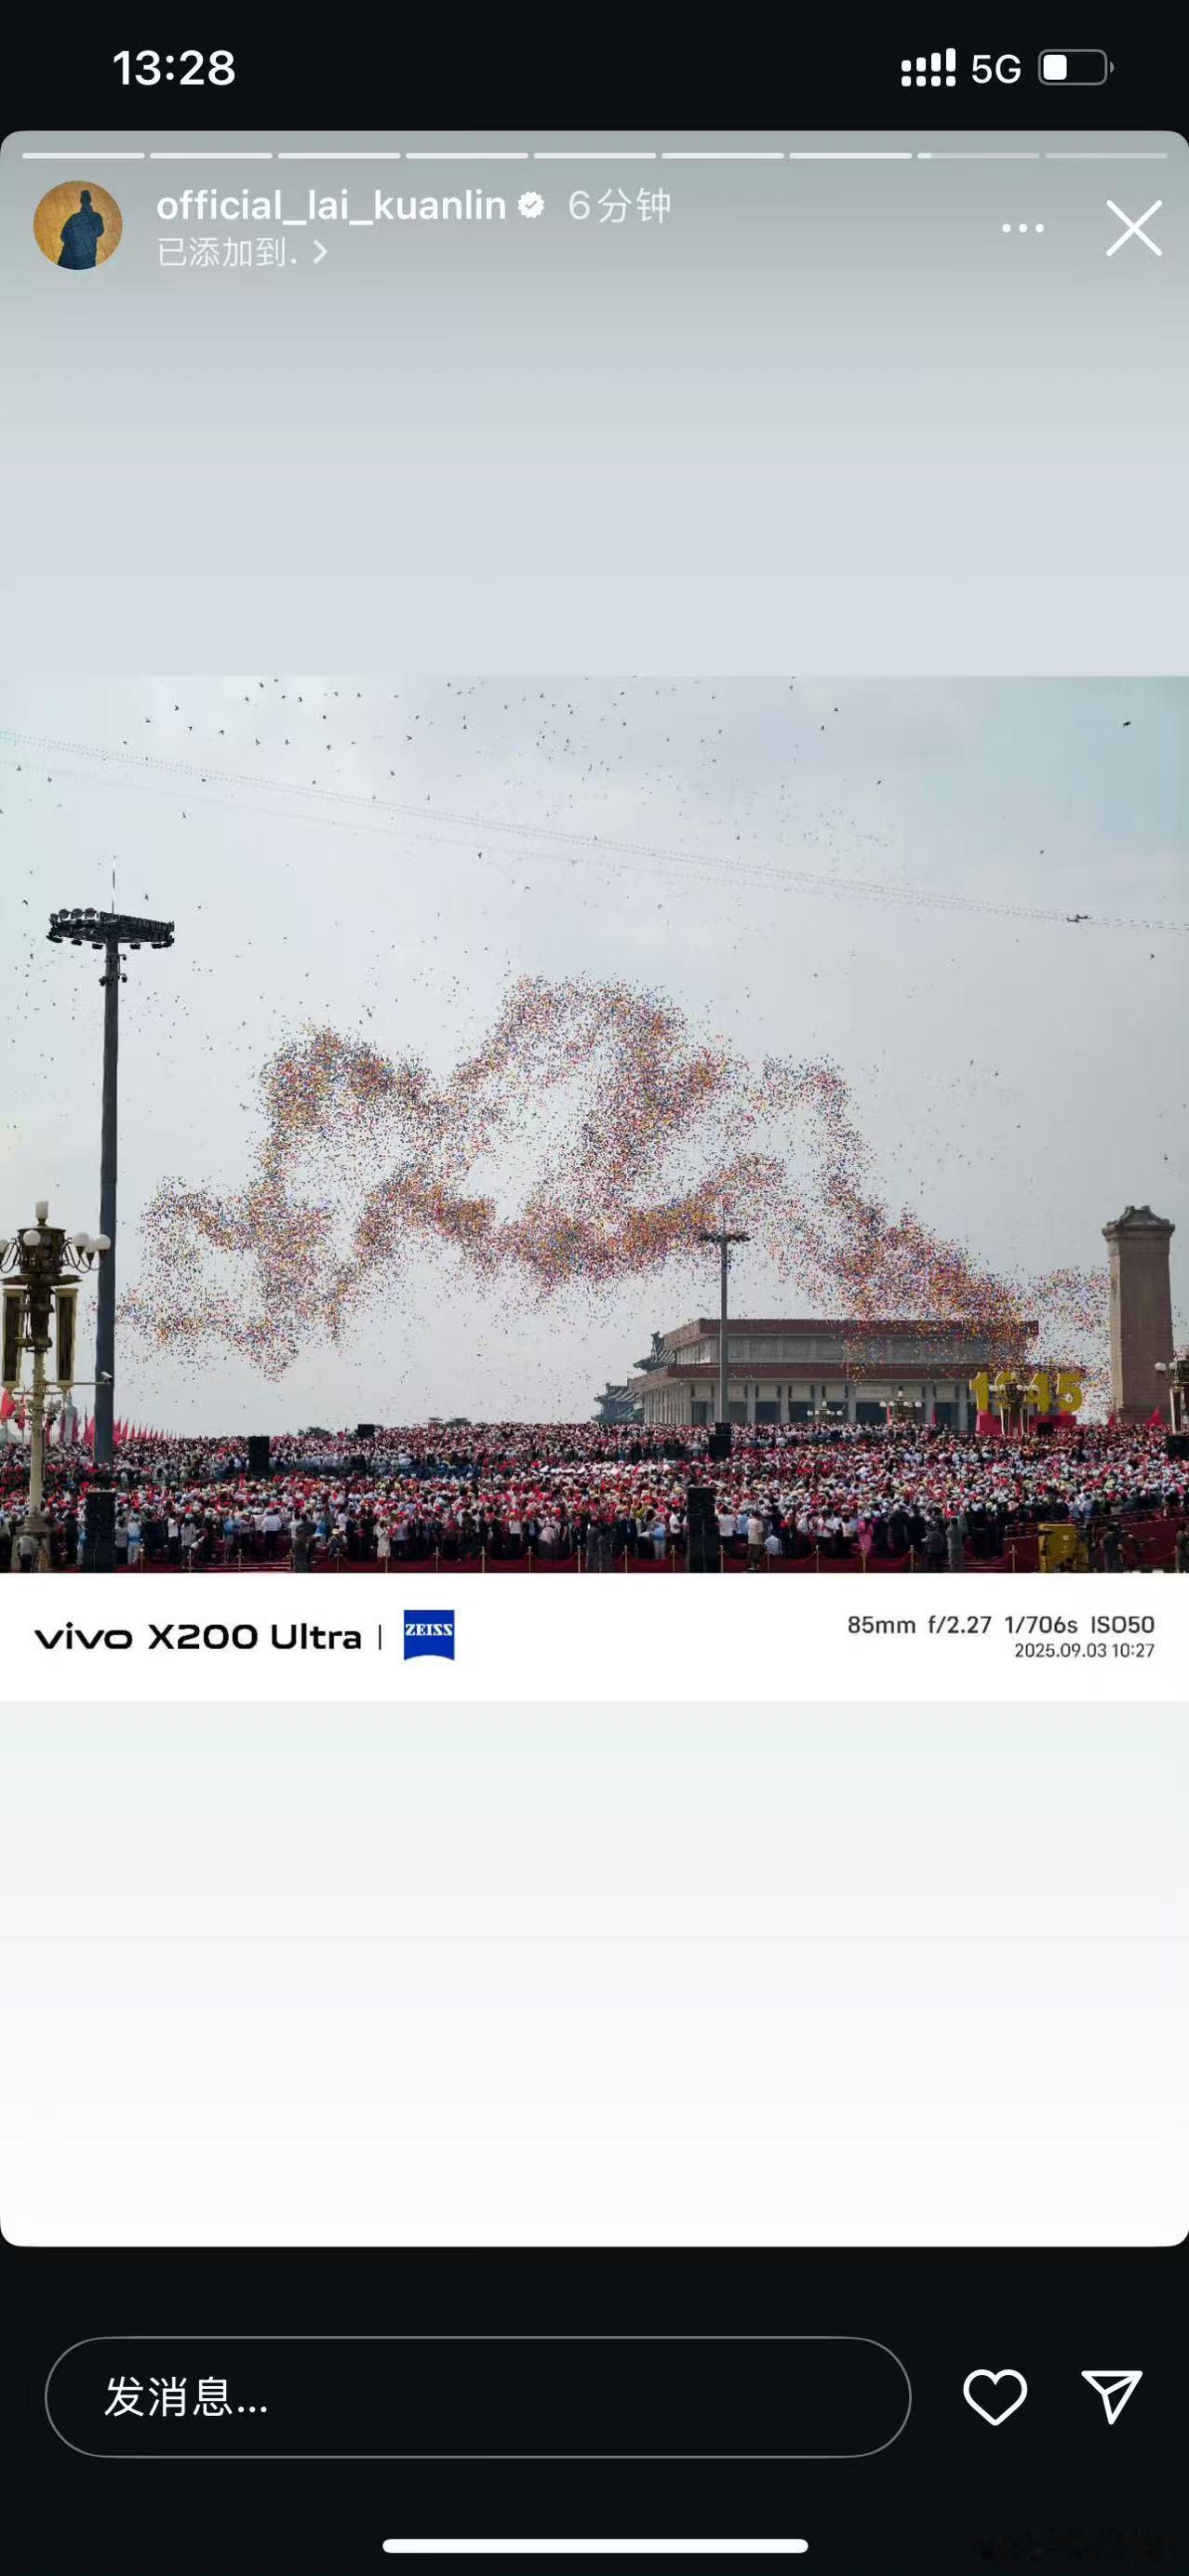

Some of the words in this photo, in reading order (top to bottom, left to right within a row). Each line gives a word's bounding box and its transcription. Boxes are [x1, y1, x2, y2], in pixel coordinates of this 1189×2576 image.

[113, 50, 236, 87] 13:28
[971, 53, 1022, 86] 5G
[156, 189, 506, 226] official_lai_kuanlin
[103, 2375, 270, 2418] 发消息...
